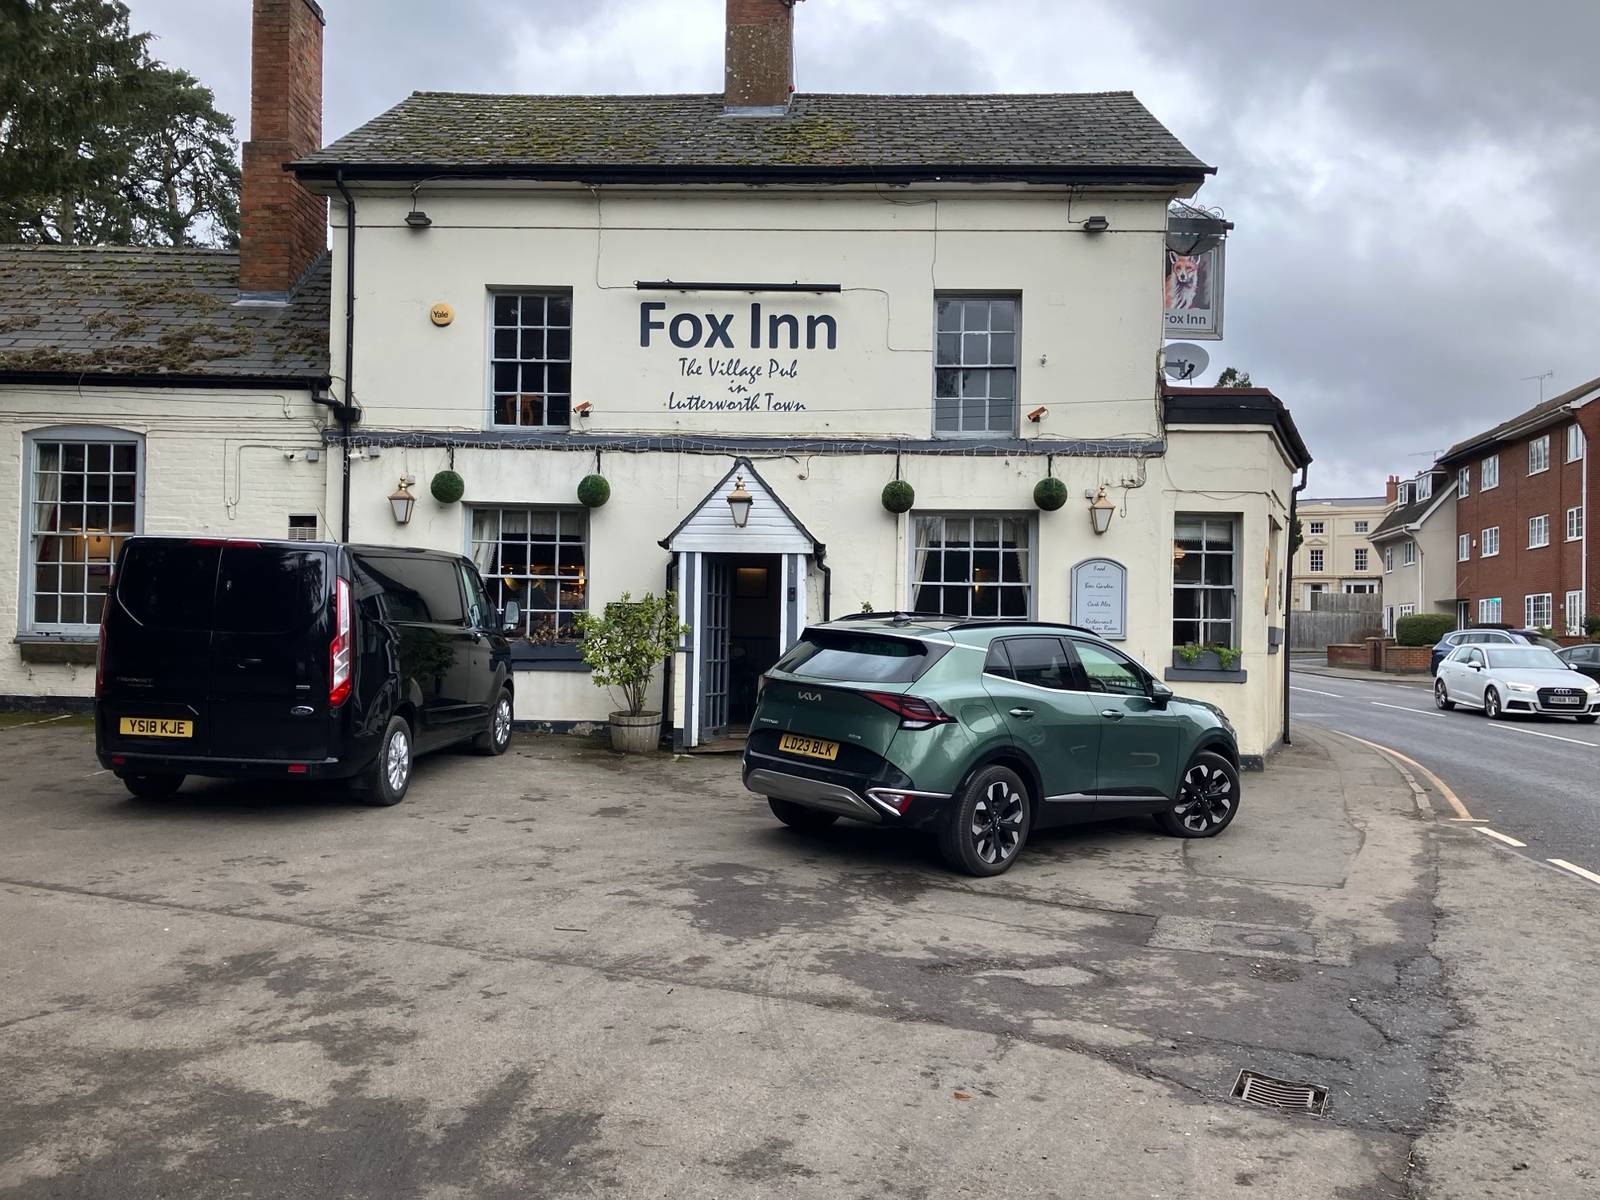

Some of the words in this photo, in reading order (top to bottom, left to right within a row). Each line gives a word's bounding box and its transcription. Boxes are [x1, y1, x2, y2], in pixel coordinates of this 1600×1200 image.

[640, 302, 735, 348] Fox
[750, 302, 837, 349] Inn
[1187, 314, 1206, 324] Inn
[678, 357, 702, 376] The
[708, 357, 762, 384] Village
[768, 358, 798, 378] Pub
[727, 380, 748, 393] in
[668, 391, 760, 411] Lutterworth
[764, 392, 806, 411] Town
[129, 719, 157, 733] YS18
[160, 720, 185, 735] KJE
[784, 736, 811, 752] LD23
[812, 741, 834, 756] BLK
